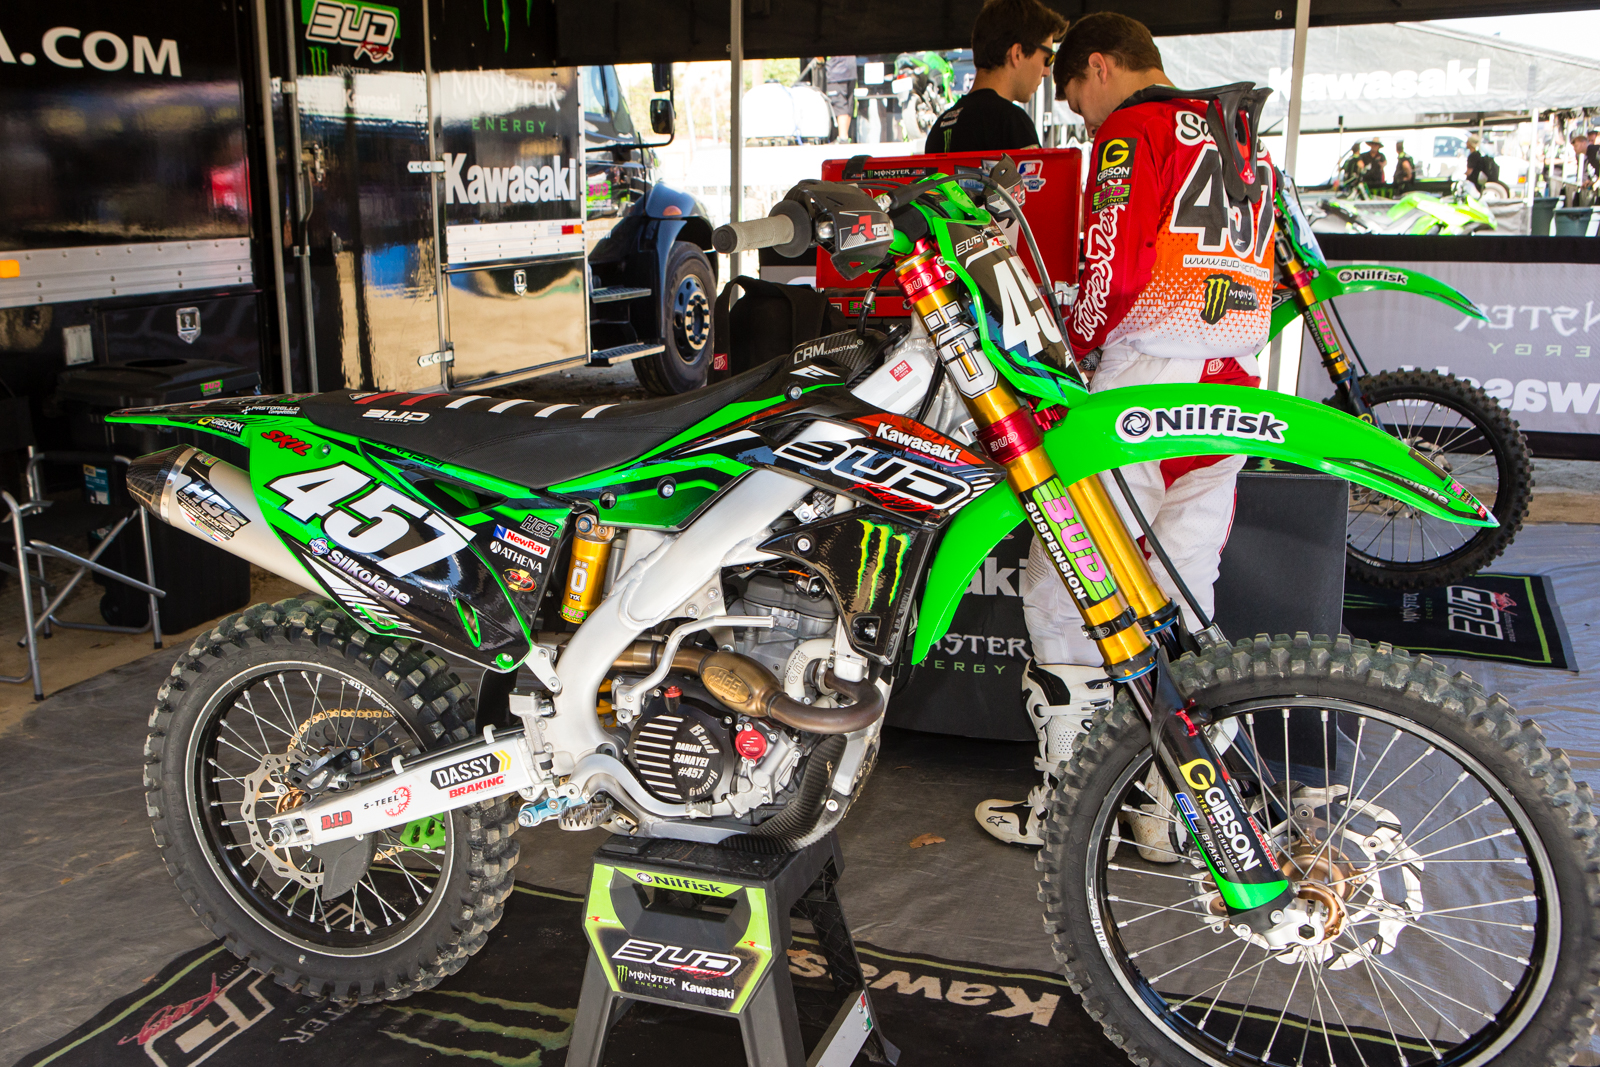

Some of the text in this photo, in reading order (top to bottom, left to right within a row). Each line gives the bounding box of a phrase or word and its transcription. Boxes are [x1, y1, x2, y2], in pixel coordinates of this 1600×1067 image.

[1268, 58, 1491, 101] Kawasaki
[472, 117, 546, 133] ENERGY
[445, 153, 577, 204] Kawasaki
[874, 168, 910, 177] MONSTER
[1097, 166, 1130, 182] GIBSON
[1098, 186, 1126, 203] BUD
[905, 273, 933, 295] BUD
[1353, 270, 1406, 284] Nilfisk
[1234, 299, 1257, 307] ENERG
[1304, 309, 1327, 353] SUSPENSION
[1312, 309, 1336, 347] BUD
[794, 342, 859, 365] CRM KARBOTANK
[210, 417, 246, 432] GIBSON
[362, 408, 431, 422] BUD
[1155, 406, 1286, 441] Nilfisk
[261, 430, 313, 456] SKIL
[875, 422, 963, 463] Kawasaki
[990, 431, 1019, 452] BUD
[772, 440, 972, 512] BUD
[183, 480, 248, 531] HGS
[266, 464, 477, 577] 457
[520, 514, 559, 540] HGS
[309, 540, 329, 555] FUCHS
[506, 531, 547, 555] NewRay
[1025, 501, 1087, 600] SUSPENSION
[1042, 496, 1107, 583] BUD
[499, 547, 542, 573] ATHENA
[327, 549, 411, 606] Silkolene
[563, 606, 585, 618] BUD
[787, 652, 809, 685] BUD
[675, 742, 702, 753] DARIAN
[689, 724, 720, 754] Bud
[436, 755, 493, 787] DASSY
[673, 753, 709, 767] SANAYEI
[678, 767, 704, 779] #457
[689, 769, 719, 796] Racing
[449, 775, 504, 798] BRAKING
[363, 795, 399, 810] S-TEEL
[1195, 794, 1242, 873] TYRE TECHNOLOGY
[1205, 787, 1261, 871] GIBSON
[1201, 833, 1227, 874] BRAKES
[653, 875, 724, 895] Nilfisk
[628, 969, 677, 987] MONSTER
[635, 981, 669, 990] ENERGY
[681, 980, 735, 1000] Kawasaki
